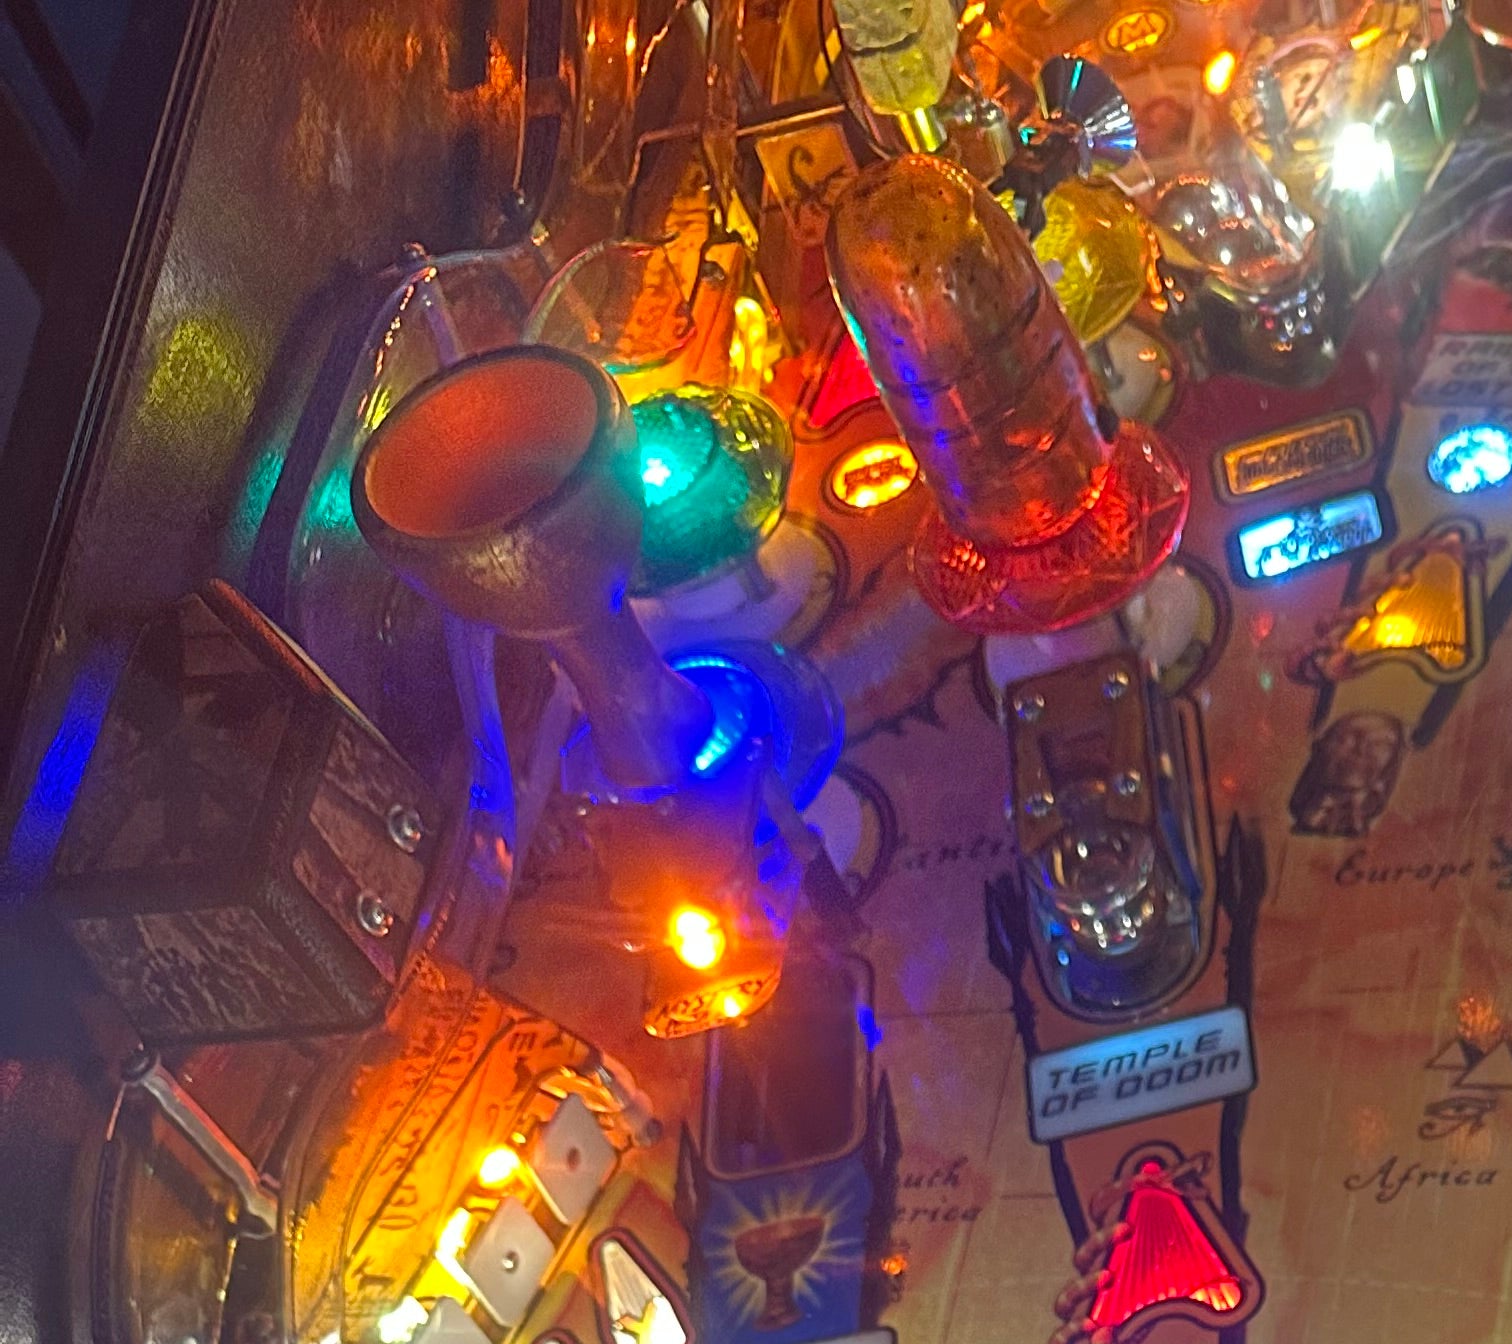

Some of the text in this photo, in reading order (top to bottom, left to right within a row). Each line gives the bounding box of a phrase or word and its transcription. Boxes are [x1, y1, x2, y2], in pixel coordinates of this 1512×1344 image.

[1335, 833, 1473, 885] Europe
[1041, 1050, 1241, 1118] OF DOOM
[1049, 1028, 1224, 1089] TEMPLE
[1343, 1155, 1498, 1206] Africa
